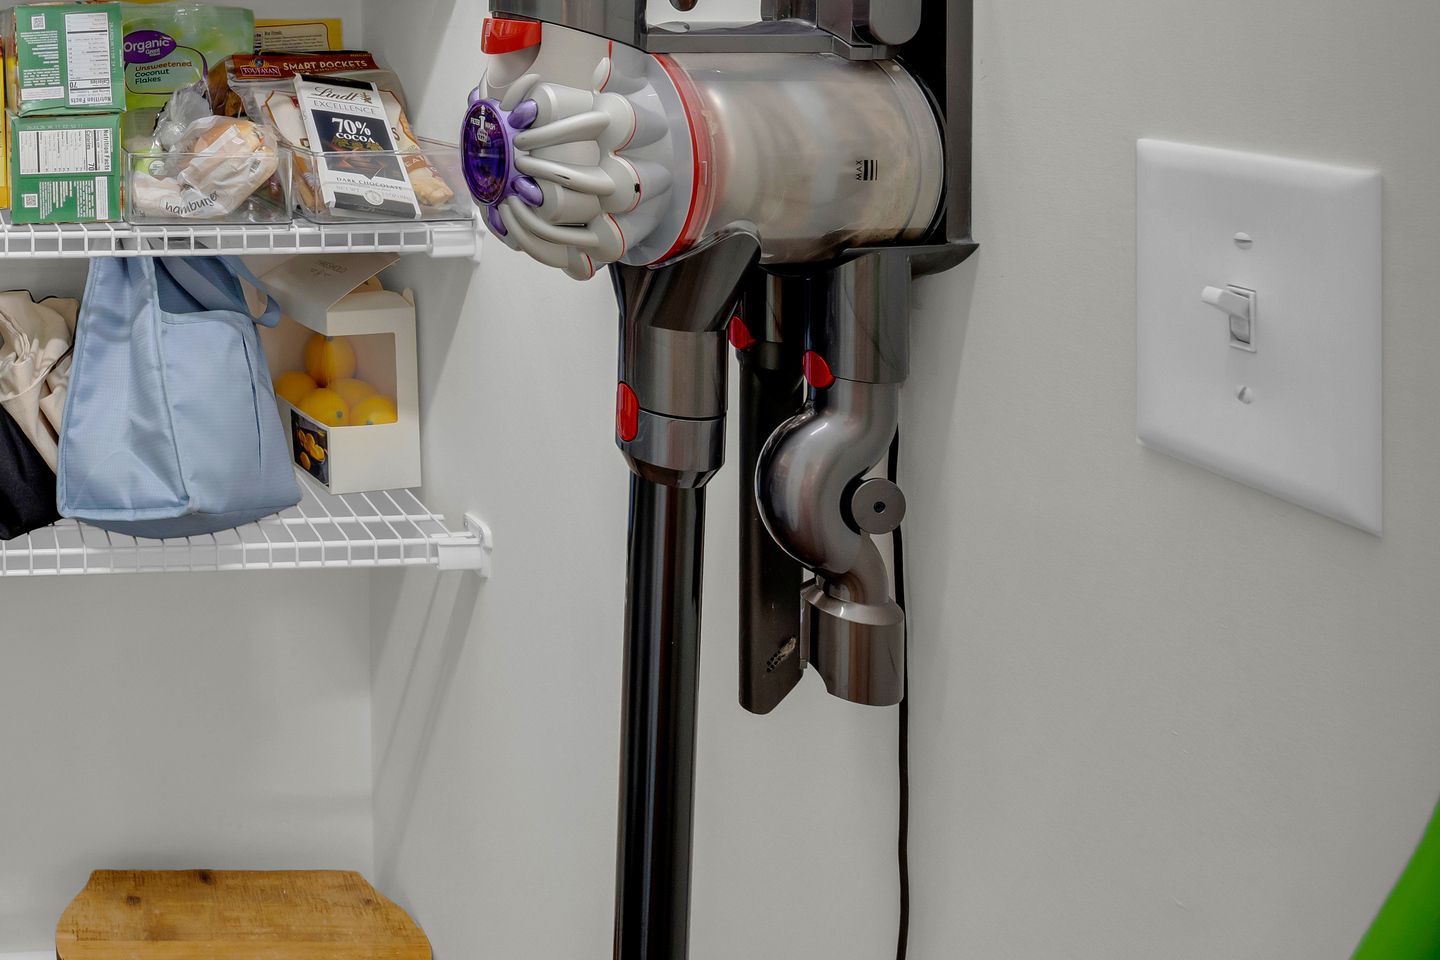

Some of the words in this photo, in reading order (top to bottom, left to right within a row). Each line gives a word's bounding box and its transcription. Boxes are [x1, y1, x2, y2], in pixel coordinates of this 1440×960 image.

[123, 37, 170, 54] Organic
[135, 61, 193, 72] Unsweetened
[283, 61, 313, 71] SMART
[314, 59, 368, 70] POCKETS
[134, 69, 170, 78] Coconut
[135, 76, 162, 85] Flakes
[313, 86, 358, 101] Lindt
[313, 99, 377, 116] EXCELLENCE
[331, 117, 371, 136] 70%
[335, 132, 375, 143] COCOA
[855, 160, 863, 181] MAX
[336, 176, 356, 184] DARK
[358, 179, 403, 190] CHOCOLATE
[165, 190, 220, 215] hamburger
